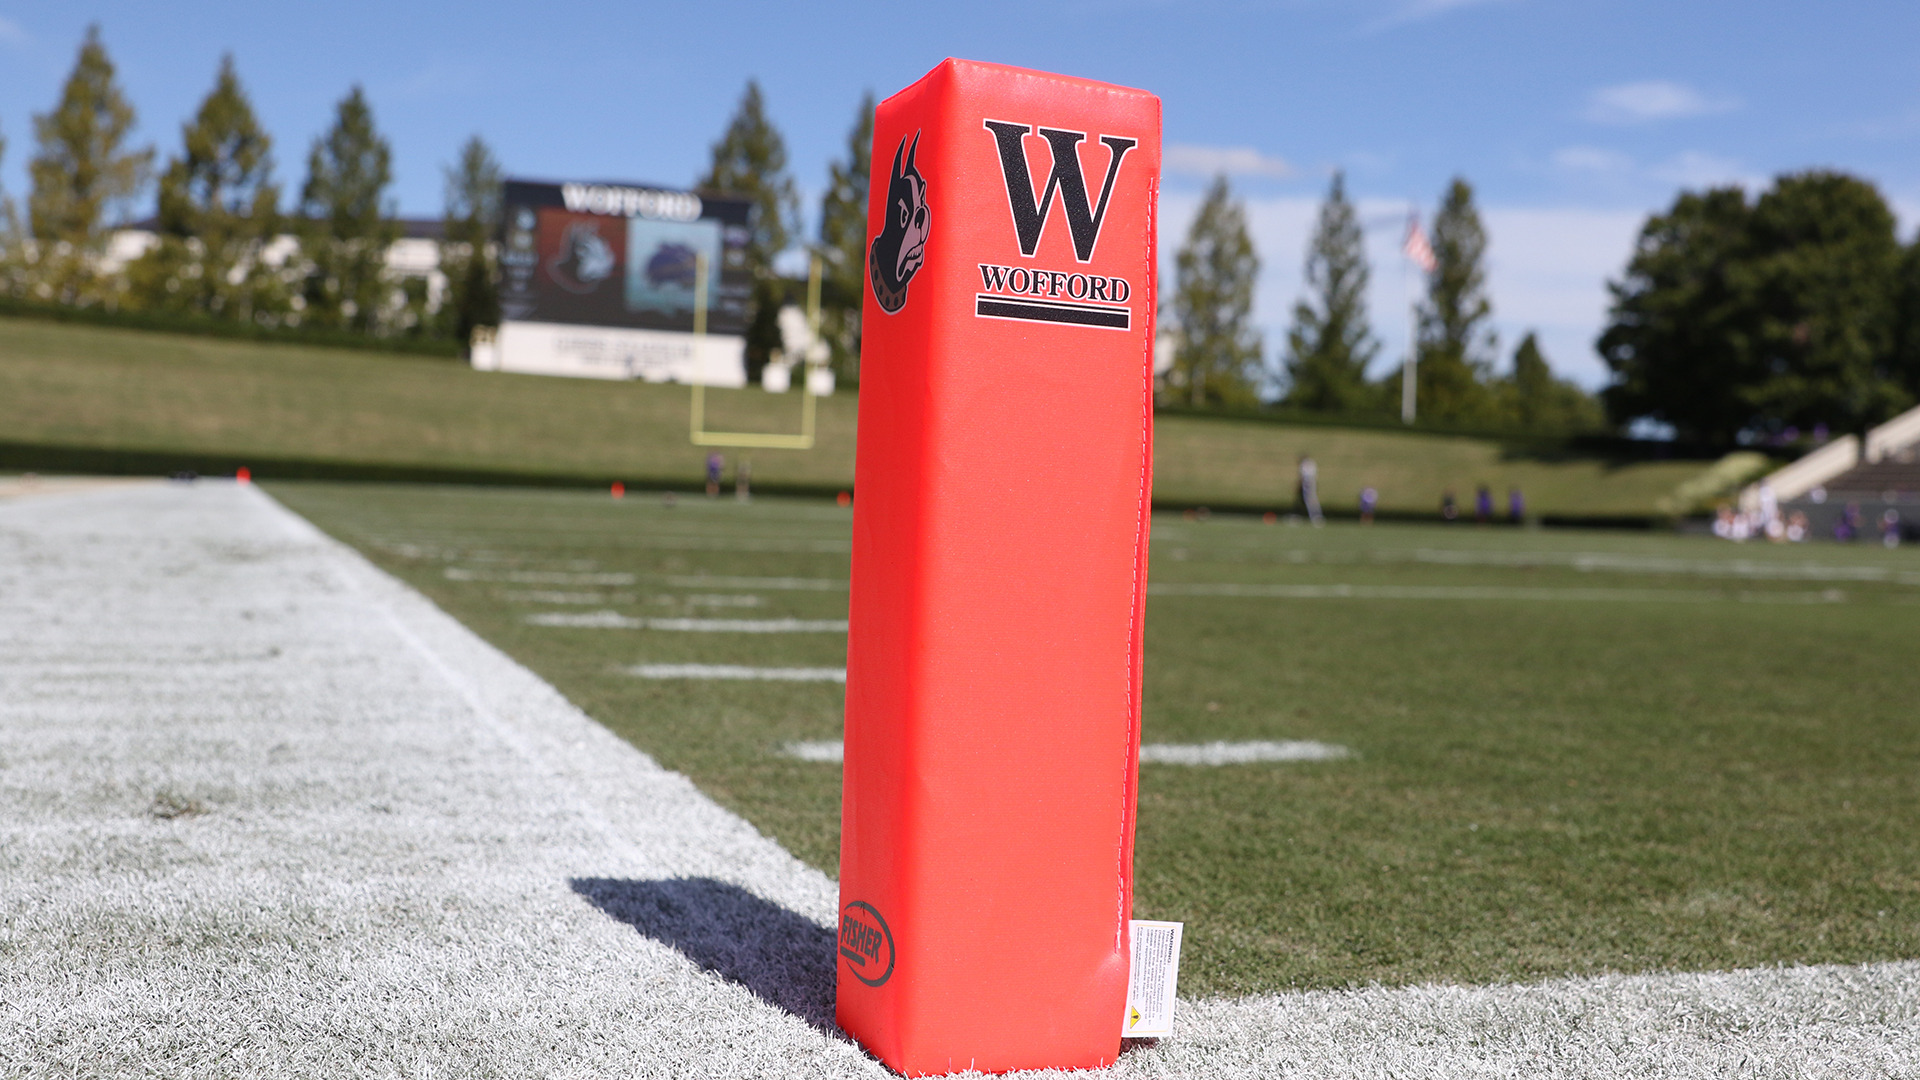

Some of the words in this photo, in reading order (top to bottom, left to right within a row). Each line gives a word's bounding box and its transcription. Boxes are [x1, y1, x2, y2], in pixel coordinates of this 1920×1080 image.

[983, 118, 1138, 264] W
[978, 263, 1131, 303] WOFFORD
[841, 914, 883, 965] FISHER
